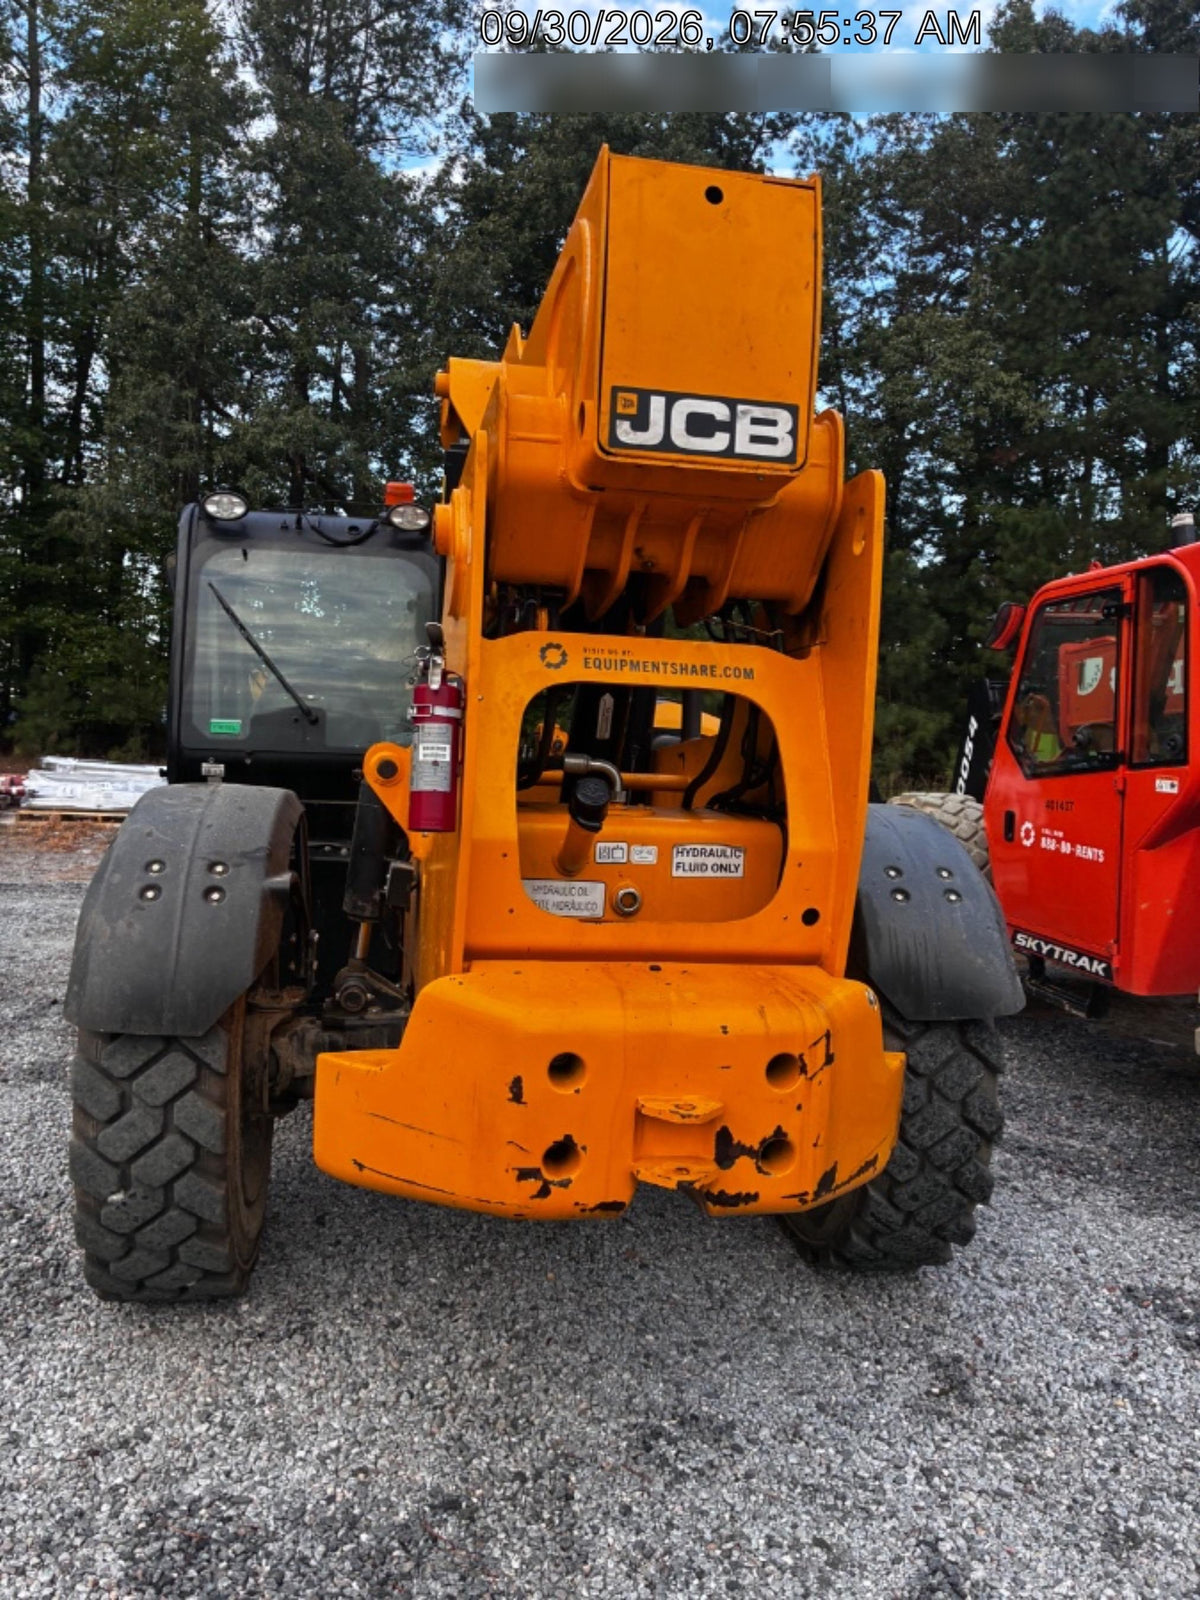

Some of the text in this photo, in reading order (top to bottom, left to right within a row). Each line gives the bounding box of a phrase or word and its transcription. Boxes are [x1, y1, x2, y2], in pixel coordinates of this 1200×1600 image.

[615, 395, 794, 458] JCB
[583, 657, 755, 680] EQUIPMENTSHARE.COM
[675, 846, 742, 859] HYDRAULIC
[675, 861, 741, 874] FLUID ONLY
[577, 886, 589, 897] OIL
[1014, 933, 1108, 977] SKYTRAK
